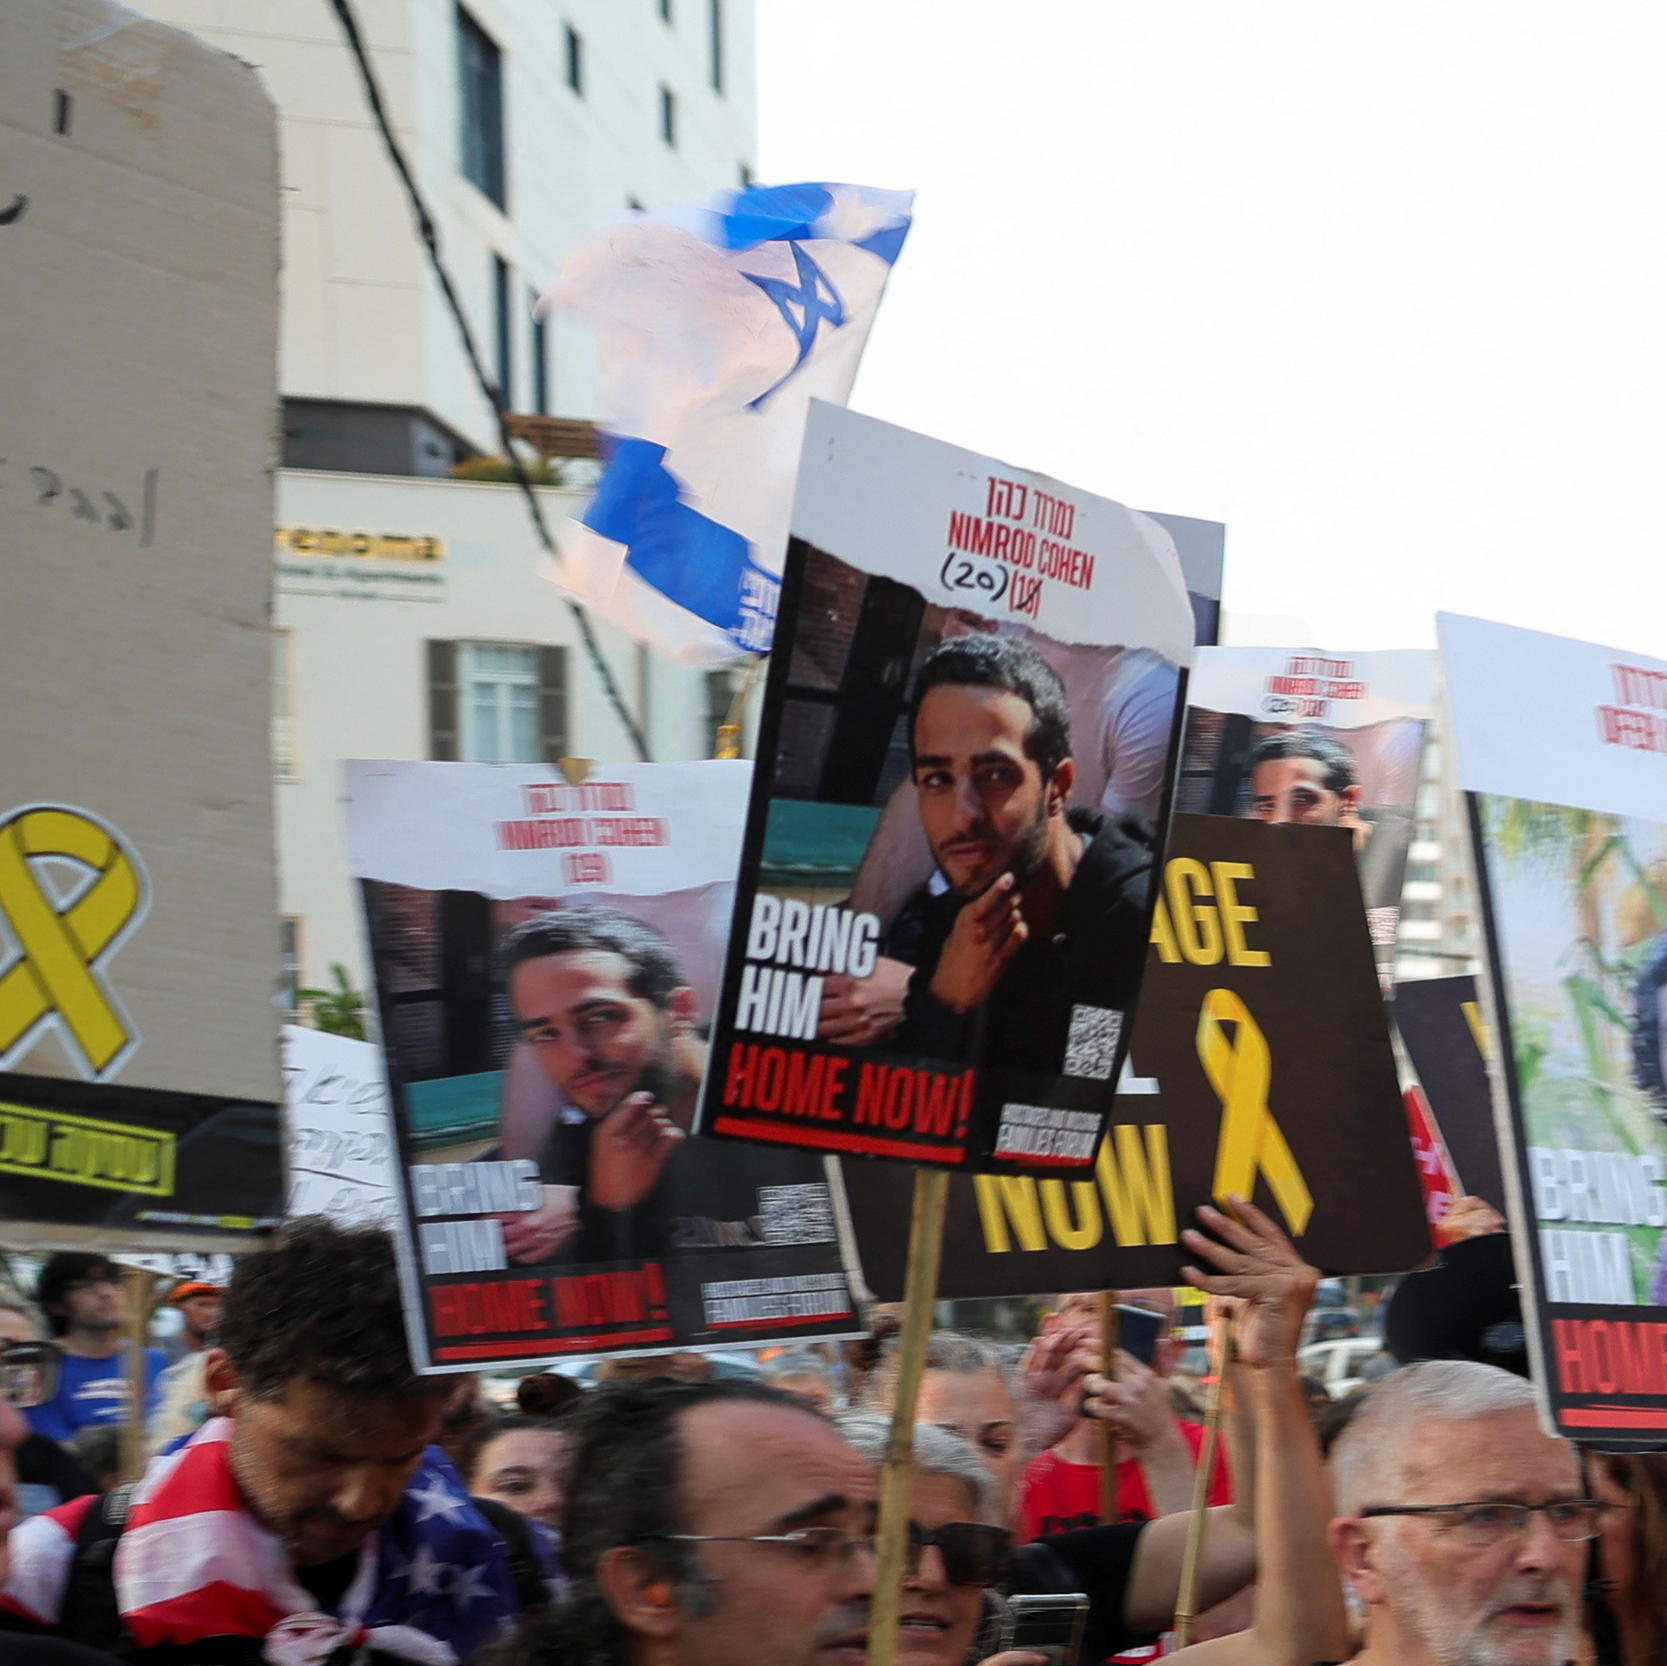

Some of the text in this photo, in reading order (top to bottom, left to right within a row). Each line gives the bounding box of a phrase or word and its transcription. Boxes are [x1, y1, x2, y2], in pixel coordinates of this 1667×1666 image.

[986, 476, 1029, 522] כהן
[940, 551, 1009, 603] (20)
[947, 509, 1096, 591] NIMROD COHEN
[745, 893, 881, 979] BRING
[1146, 856, 1273, 966] AGE
[734, 963, 825, 1041] HIM
[721, 1041, 976, 1140] HOME NOW!
[410, 1159, 542, 1217] BRING
[973, 1123, 1178, 1254] NOW
[417, 1215, 508, 1276] HIM
[1539, 1228, 1636, 1305] HIM
[426, 1277, 549, 1338] HOME
[552, 1262, 672, 1328] NOW!
